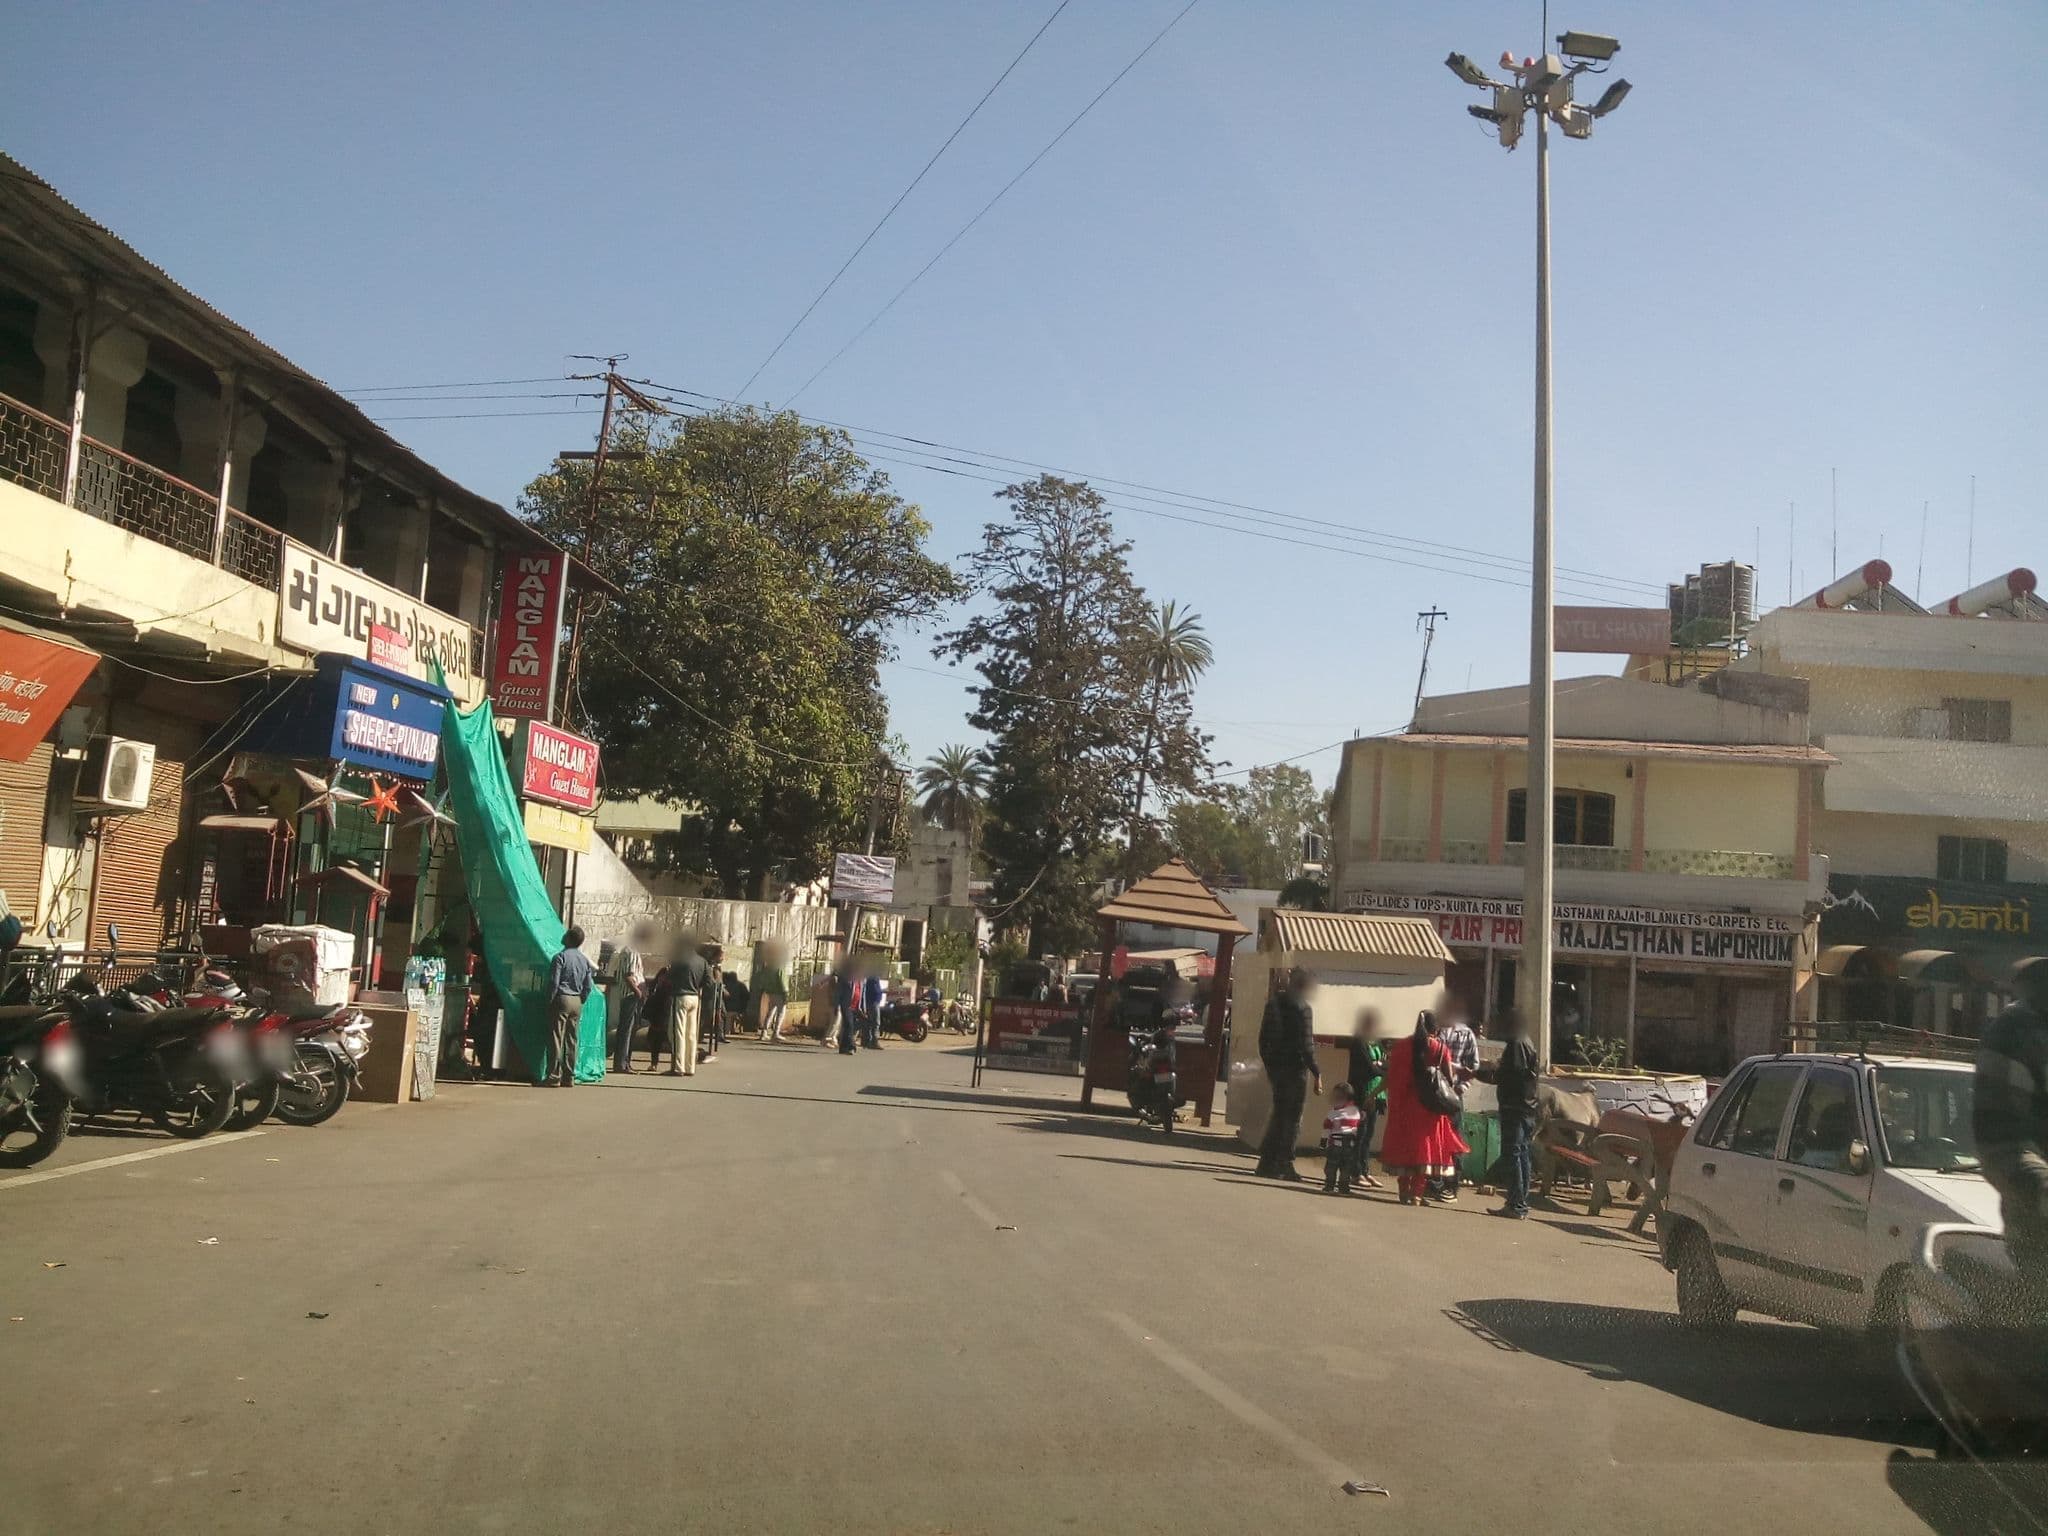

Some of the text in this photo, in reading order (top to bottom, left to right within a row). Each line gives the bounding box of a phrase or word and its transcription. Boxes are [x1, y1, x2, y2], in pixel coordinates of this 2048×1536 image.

[508, 557, 550, 676] MANGLAM
[353, 683, 378, 705] NEW
[496, 695, 542, 710] House
[500, 682, 543, 697] Guest
[347, 710, 439, 763] SHER-E-PUNJAB
[532, 732, 587, 773] MANGLAM
[550, 771, 590, 799] Guest House
[1377, 896, 1409, 909] LADIES
[1415, 898, 1441, 911] TOPS
[1447, 900, 1479, 913] KURTA
[1482, 901, 1502, 915] FOR
[1607, 908, 1640, 923] RAJAI
[1645, 911, 1701, 926] BLANKETS
[1708, 915, 1761, 930] CARPETS
[1437, 914, 1482, 942] FAIR
[1905, 888, 2030, 934] shanti
[1559, 921, 1795, 962] RAJASTHAN EMPORIUM
